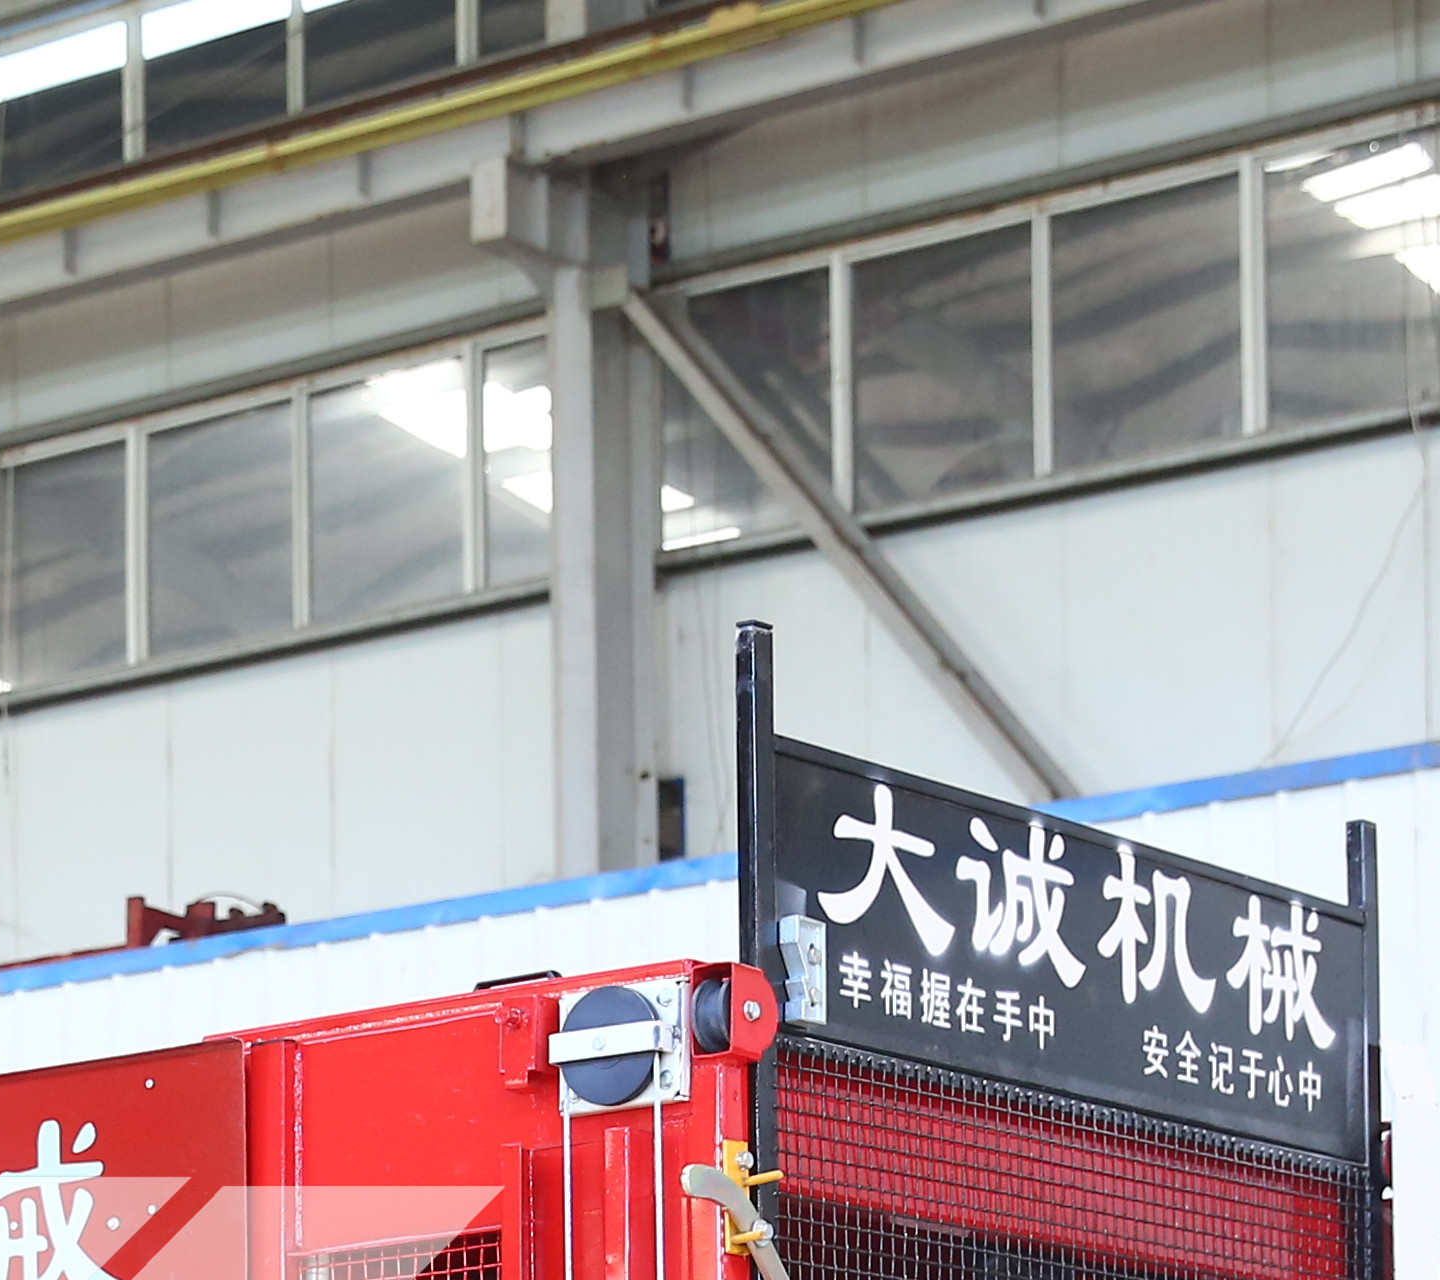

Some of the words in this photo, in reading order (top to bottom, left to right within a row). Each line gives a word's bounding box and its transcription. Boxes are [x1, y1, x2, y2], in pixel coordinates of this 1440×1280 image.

[817, 783, 1337, 1050] 大诚机械
[837, 950, 1057, 1050] 幸福握在手中
[1142, 1025, 1323, 1112] 安全记于心中
